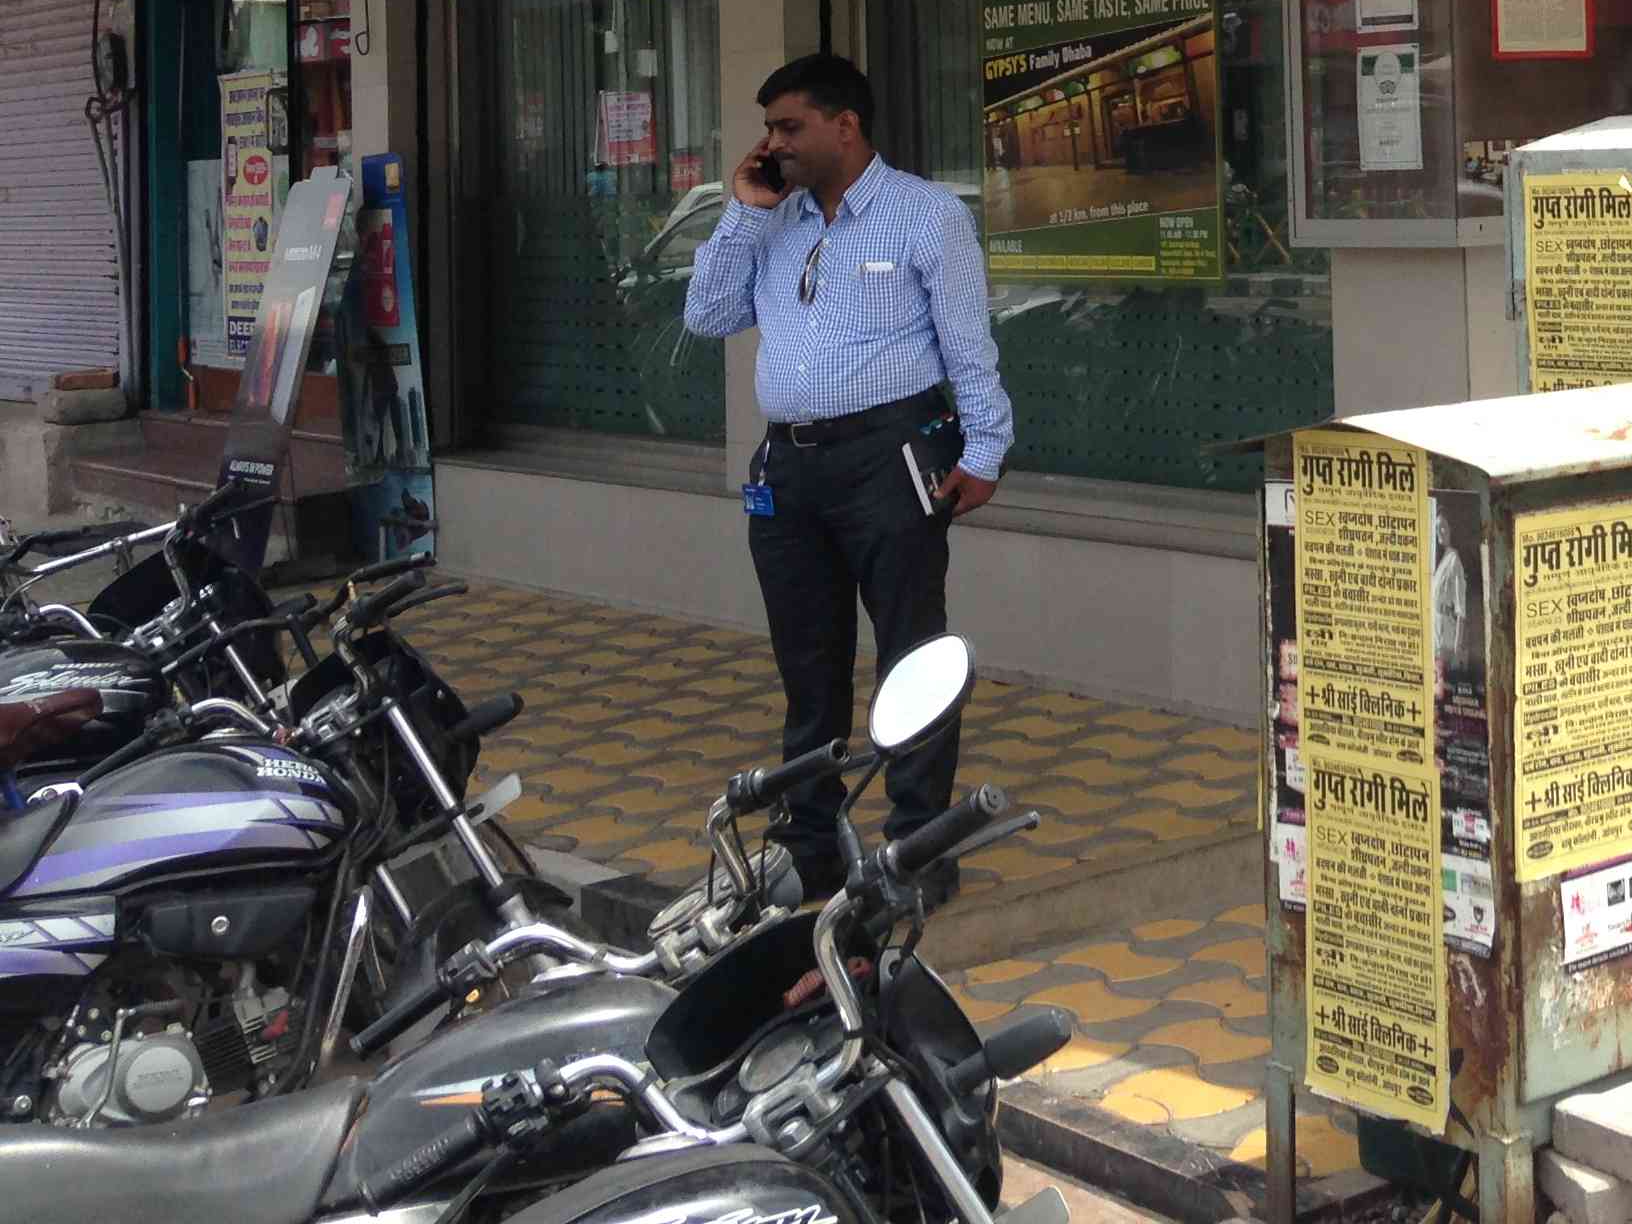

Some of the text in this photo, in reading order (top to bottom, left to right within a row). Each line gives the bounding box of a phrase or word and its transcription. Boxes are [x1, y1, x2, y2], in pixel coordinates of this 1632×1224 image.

[984, 5, 1014, 29] SAME
[1017, 2, 1054, 26] MENU,
[1029, 52, 1059, 71] Family
[1062, 45, 1092, 64] Dhaba
[1127, 200, 1149, 218] place
[1564, 187, 1596, 219] रोगी
[1536, 241, 1562, 253] SEX
[1336, 448, 1373, 489] रोगी
[1304, 510, 1336, 527] SEX
[1523, 540, 1562, 588] गुप्त
[1566, 525, 1608, 567] रोगी
[1526, 599, 1563, 618] SEX
[257, 767, 327, 785] HONDA
[1348, 768, 1387, 814] रोगी
[1544, 781, 1560, 809] श्री
[1316, 825, 1348, 846] SEX
